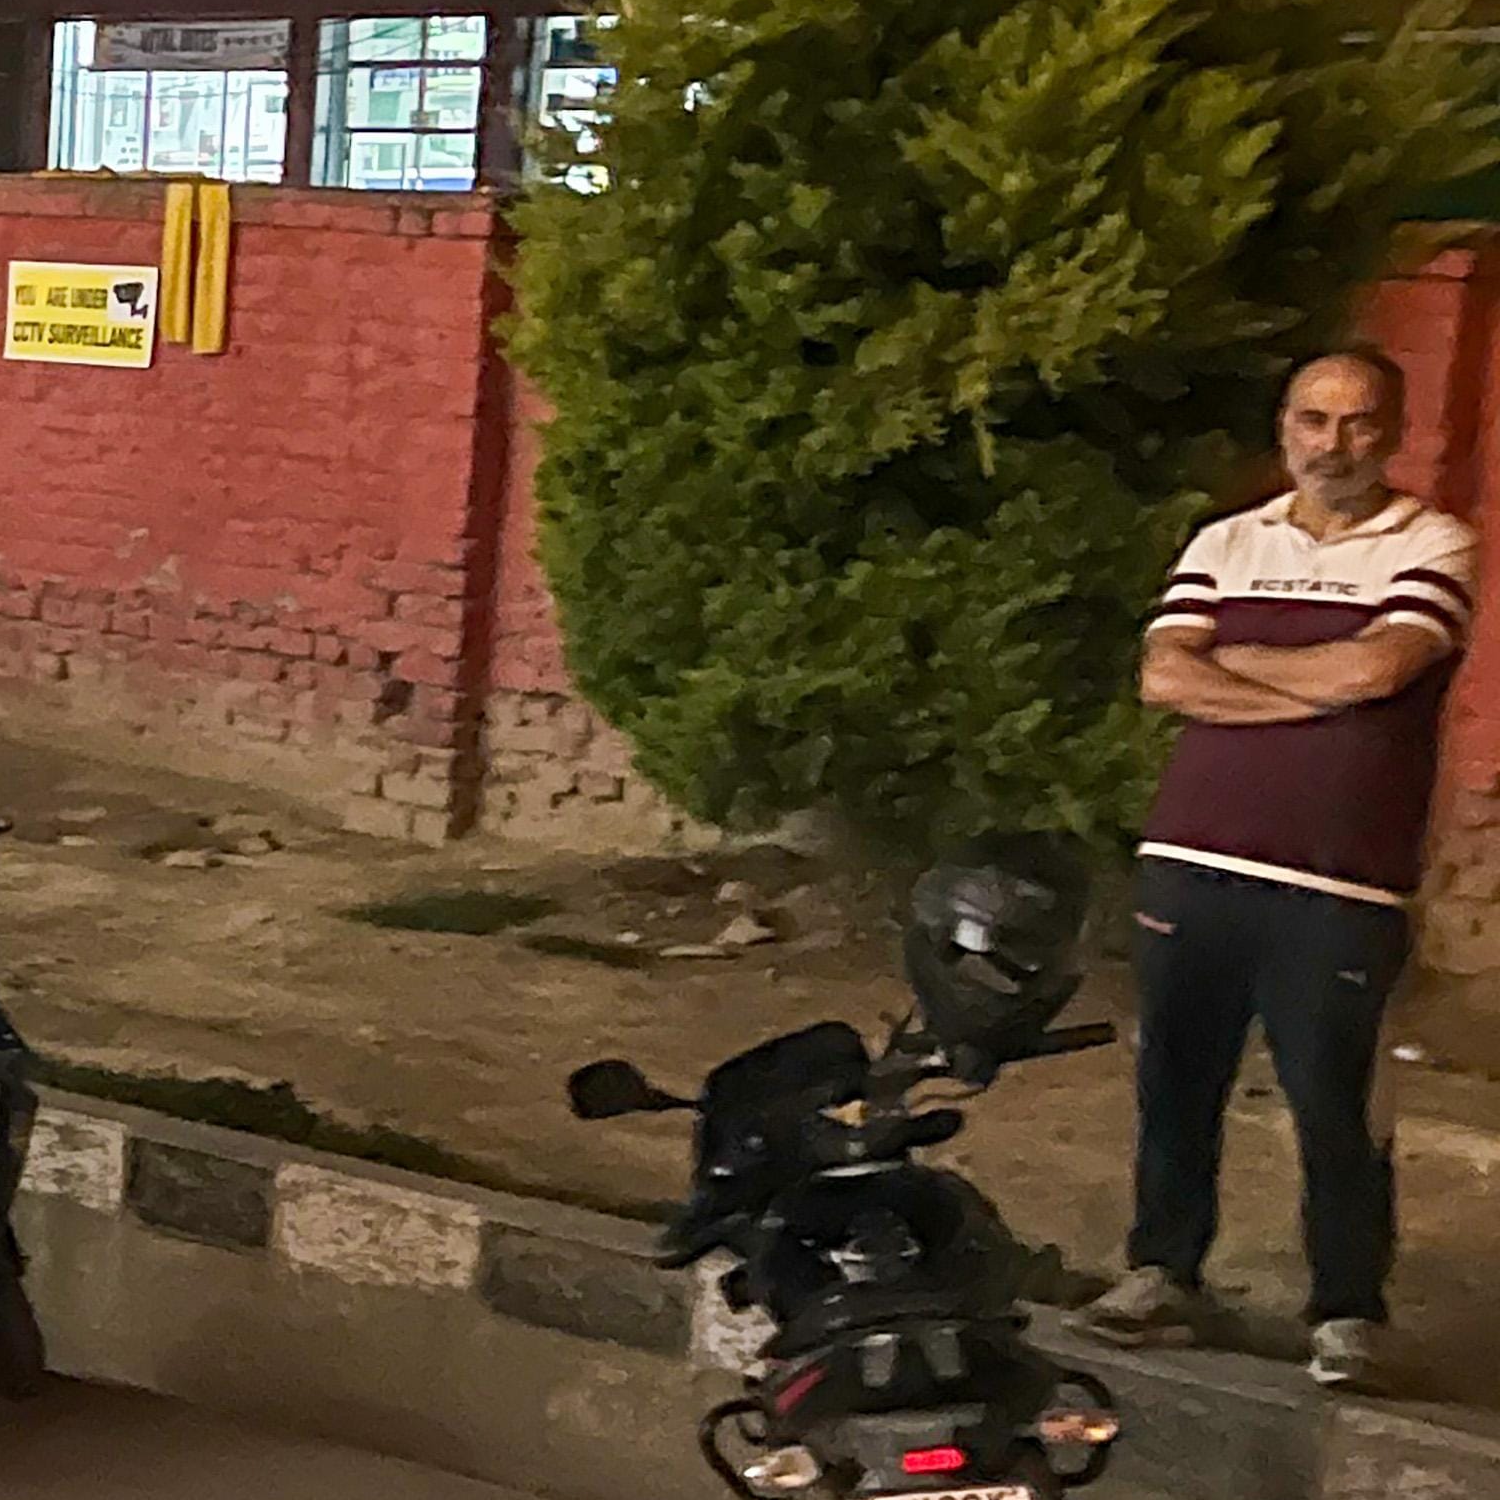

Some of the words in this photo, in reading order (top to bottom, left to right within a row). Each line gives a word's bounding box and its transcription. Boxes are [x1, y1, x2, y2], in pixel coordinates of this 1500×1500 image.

[46, 285, 68, 308] ARE
[13, 321, 46, 342] CCTV
[47, 323, 144, 349] SURVEILLANCE
[1250, 579, 1359, 596] ECSTATIC
